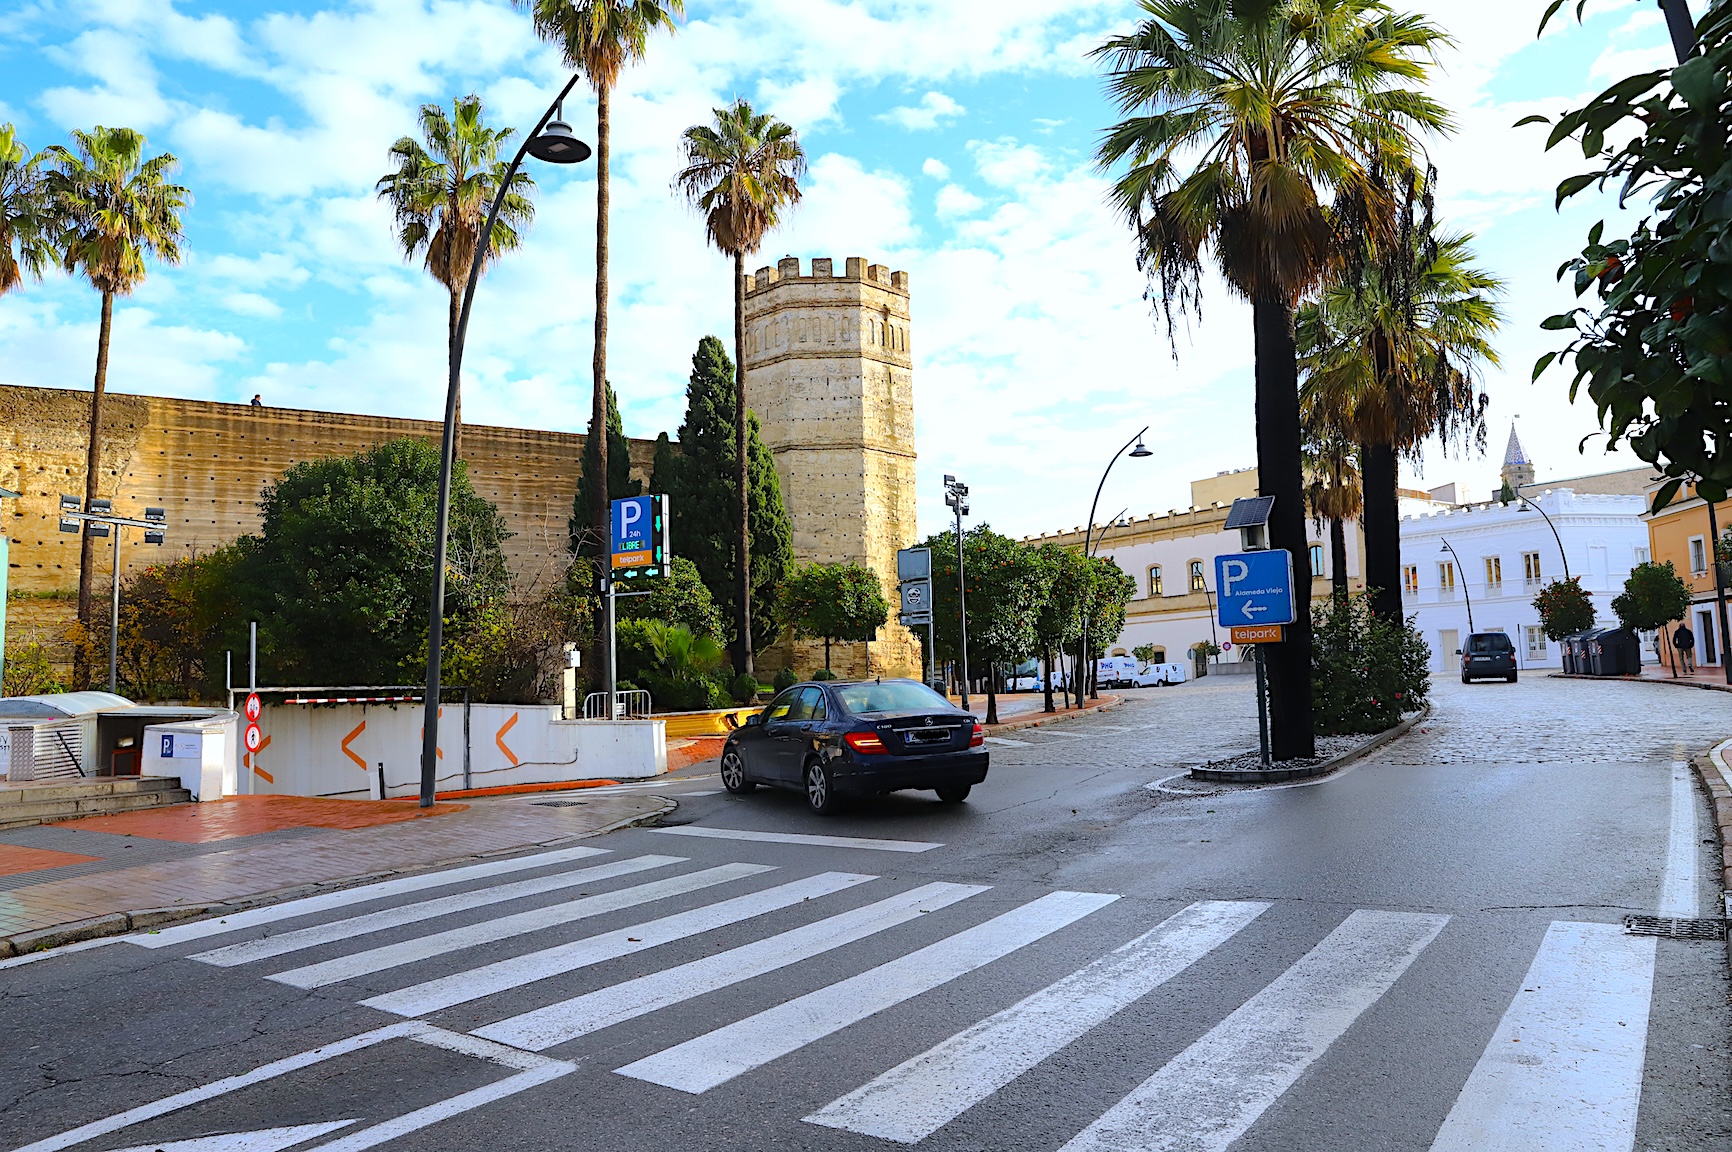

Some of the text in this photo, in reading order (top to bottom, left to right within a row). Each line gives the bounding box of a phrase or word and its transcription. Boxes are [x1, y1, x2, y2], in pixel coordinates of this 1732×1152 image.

[620, 500, 642, 539] P
[622, 540, 640, 550] LIBRE
[619, 554, 645, 564] telpark
[1222, 560, 1248, 597] P
[1234, 628, 1276, 640] telpark
[163, 739, 170, 754] P
